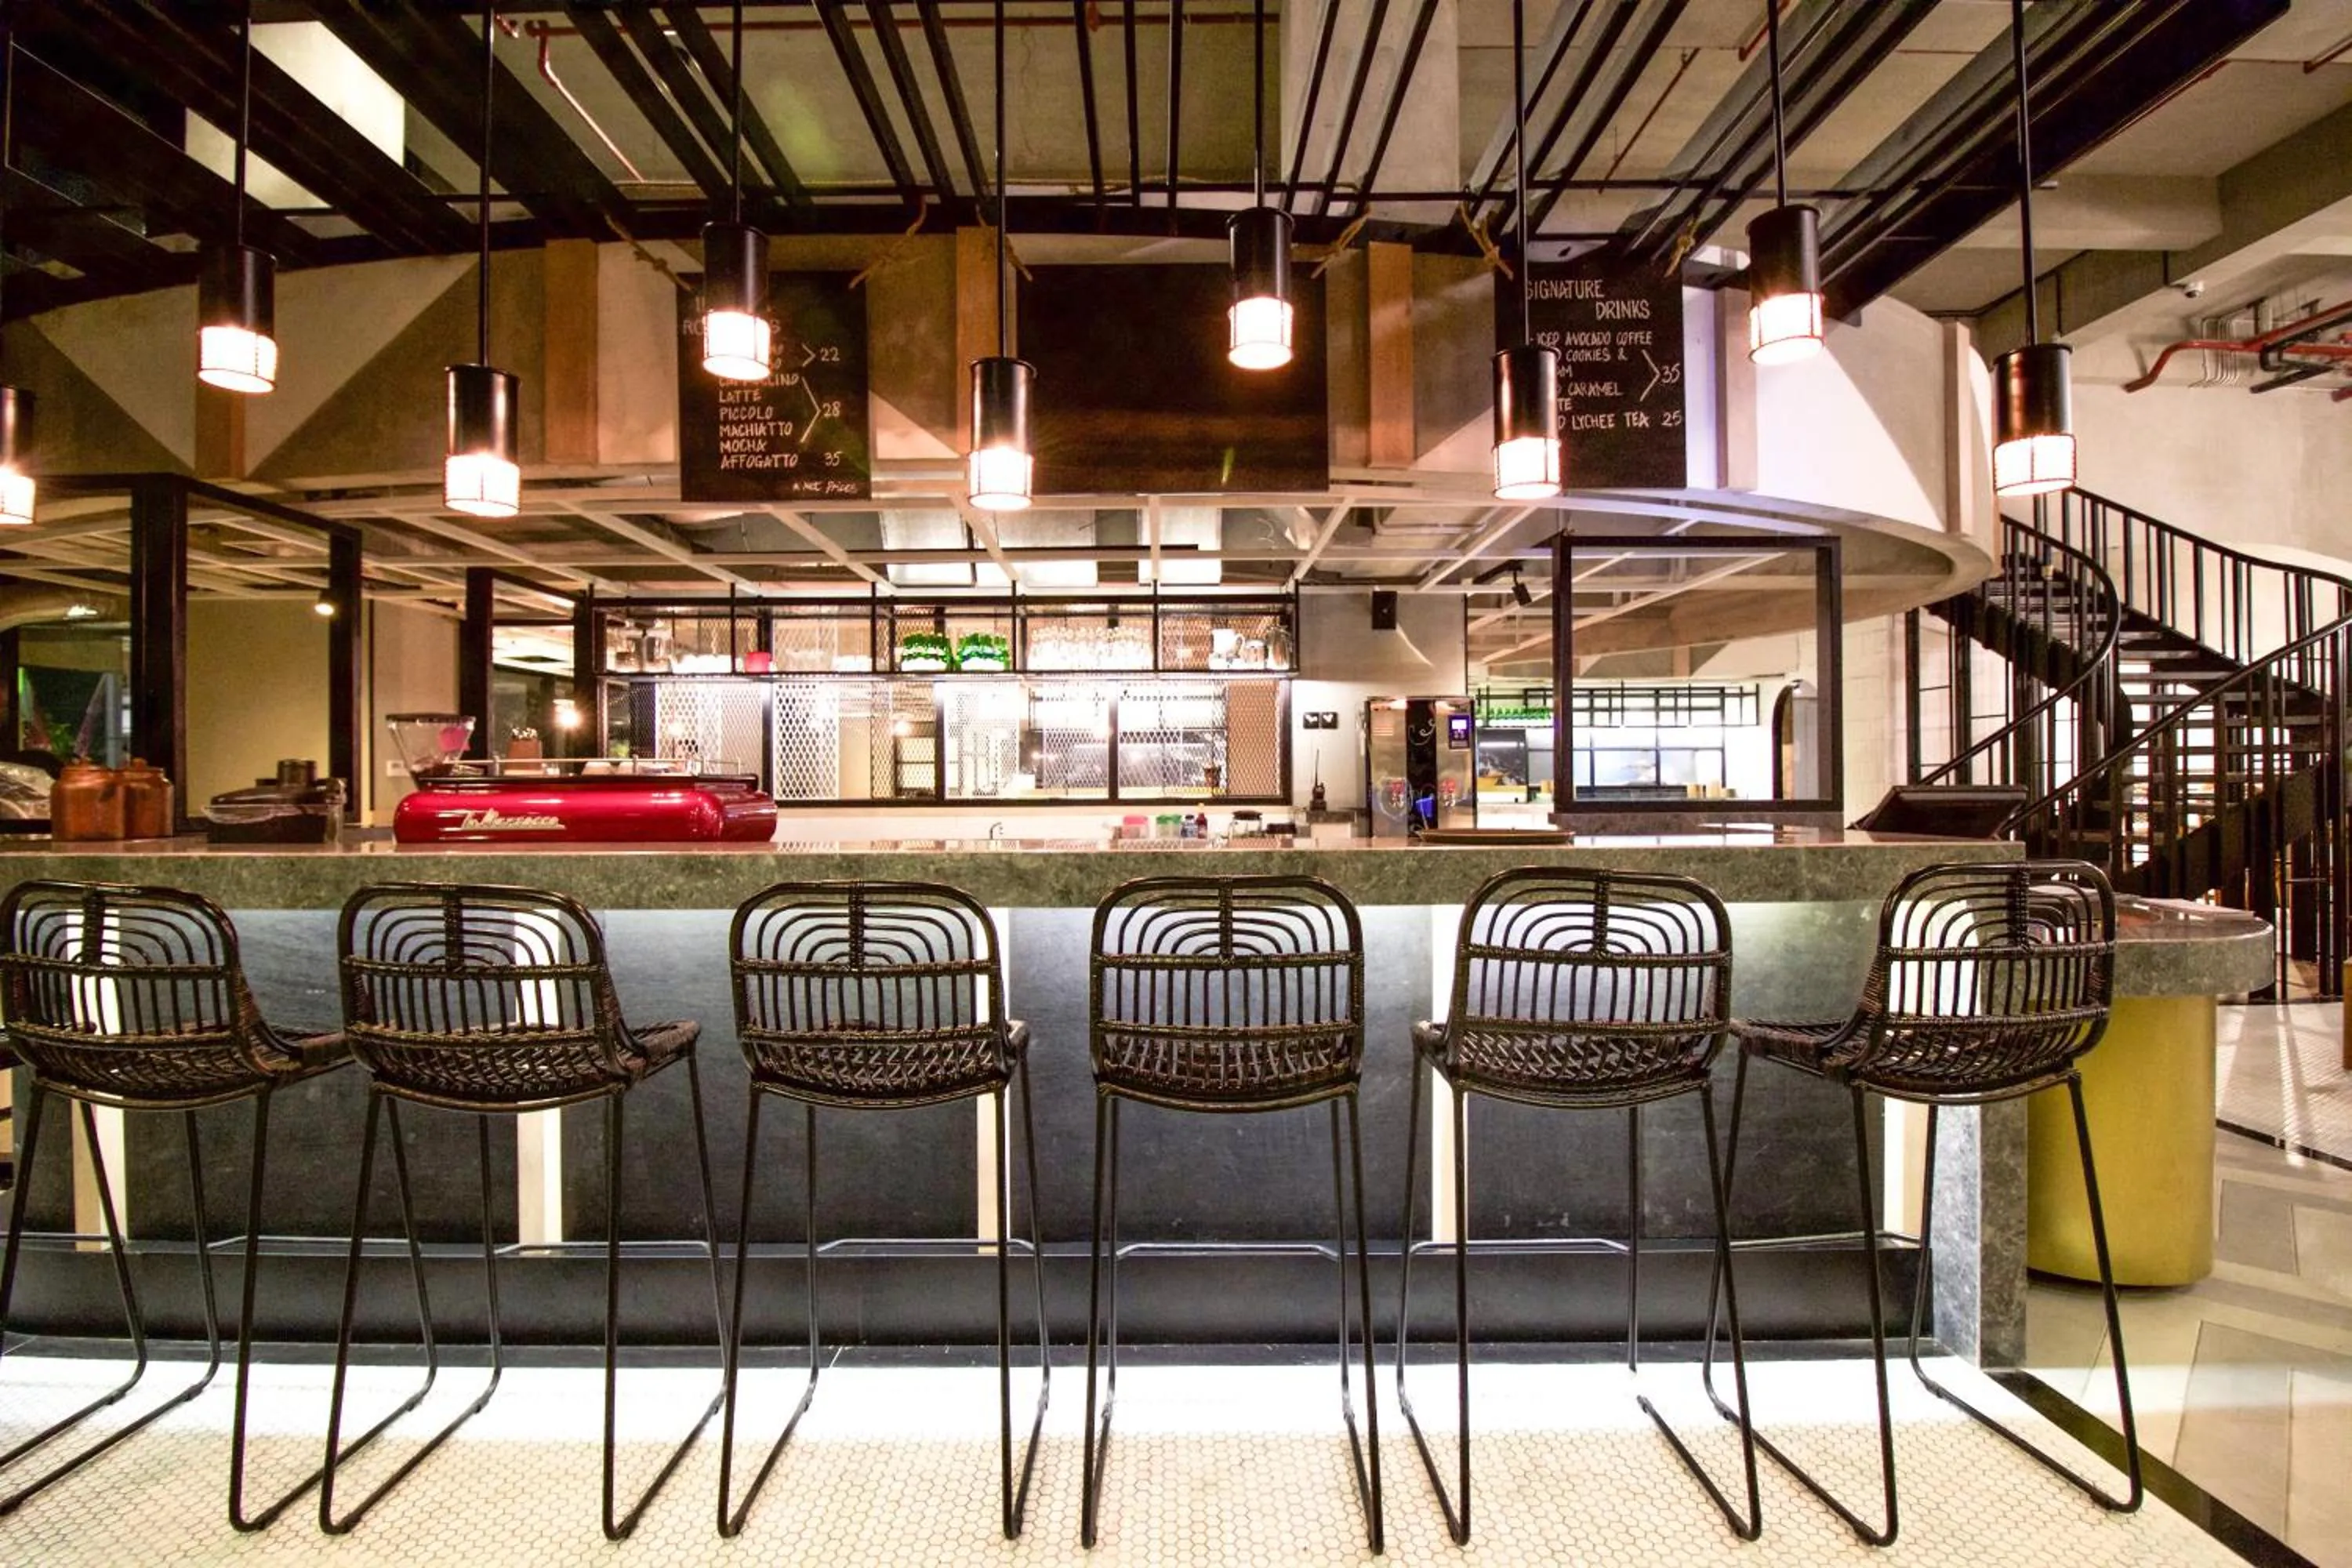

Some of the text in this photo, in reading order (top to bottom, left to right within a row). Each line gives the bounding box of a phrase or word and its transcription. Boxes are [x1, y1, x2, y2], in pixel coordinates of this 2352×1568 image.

[1527, 279, 1605, 300] SIGNATURE
[1595, 299, 1650, 321] DRINKS
[1565, 331, 1611, 346] AVOCADO
[1616, 331, 1653, 346] COFFEE
[821, 347, 840, 361] 22
[1566, 348, 1611, 362] COOKIES
[1661, 362, 1681, 383] 35
[719, 389, 762, 404] LATTE
[1568, 381, 1624, 397] CARAMEL
[719, 405, 774, 421] PICCOLO
[823, 401, 841, 418] 28
[1572, 413, 1616, 430] LYCHEE
[1624, 412, 1650, 427] TEA
[1661, 410, 1682, 426] 25
[719, 421, 793, 437] MACHIATTO
[719, 437, 768, 453] MOCHA
[720, 451, 844, 470] AFFOGATTO 35
